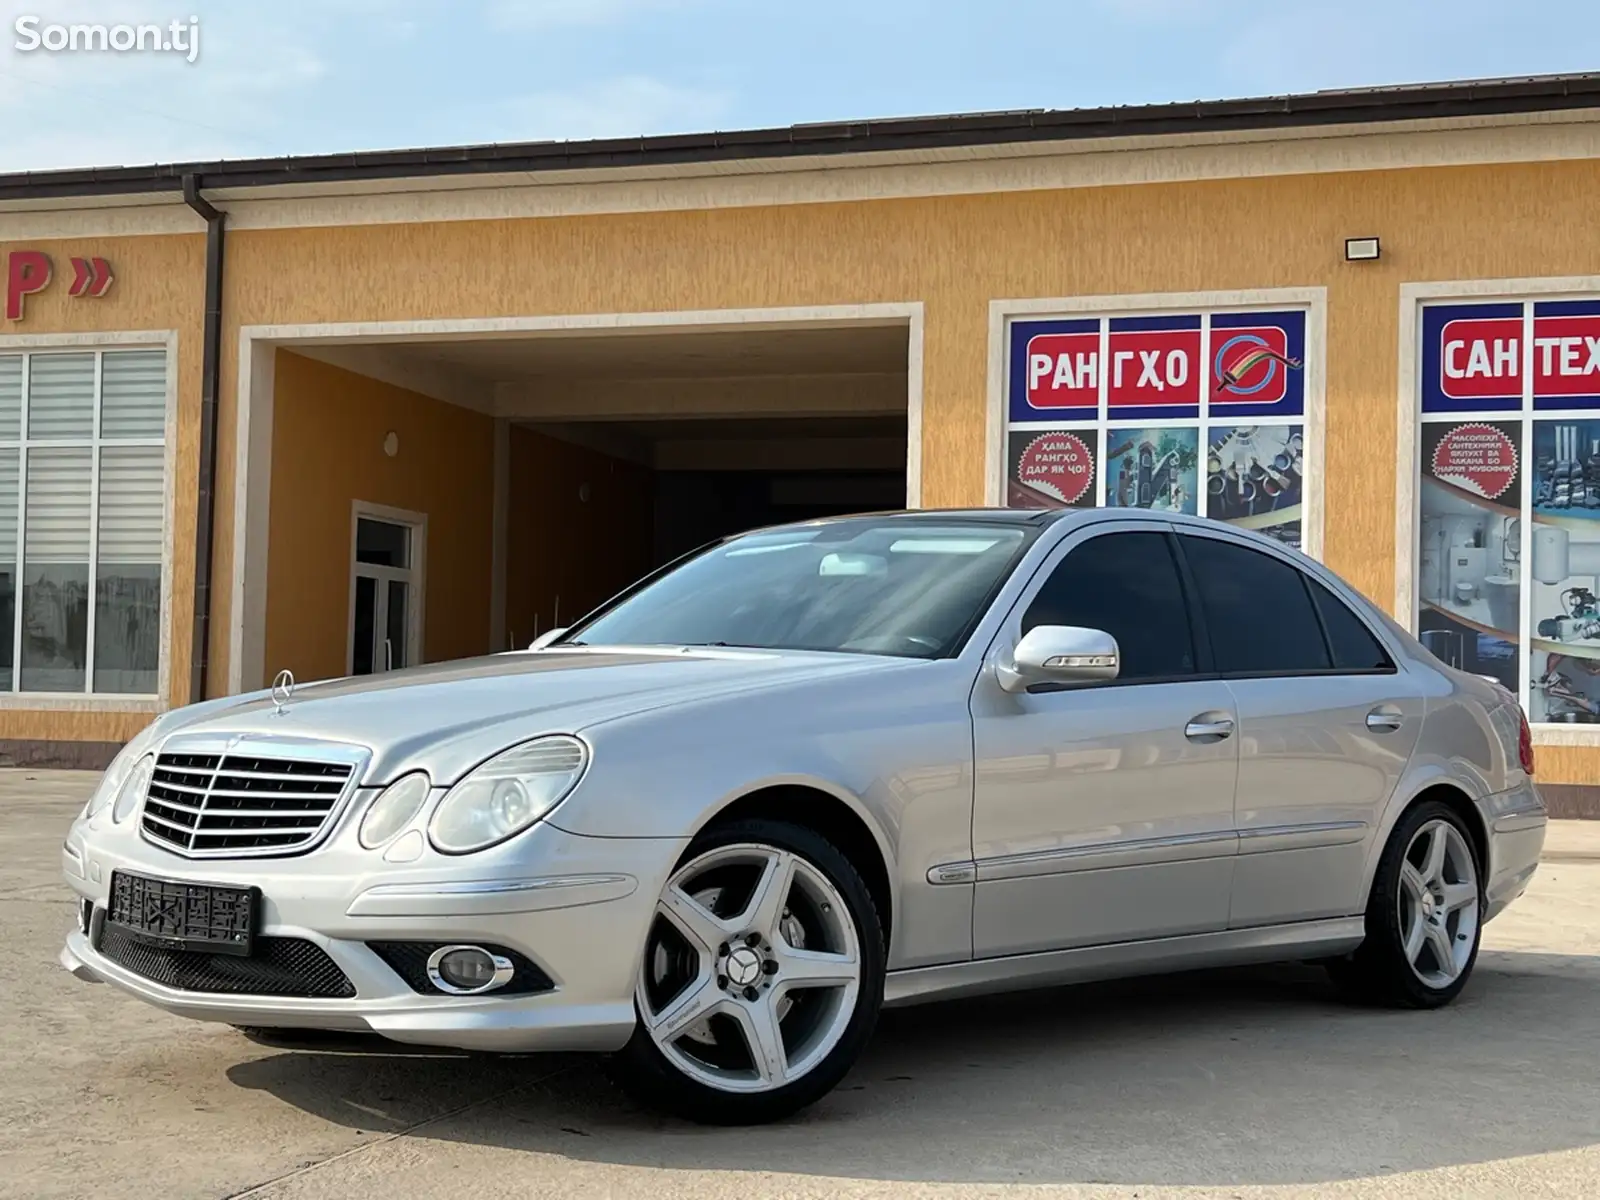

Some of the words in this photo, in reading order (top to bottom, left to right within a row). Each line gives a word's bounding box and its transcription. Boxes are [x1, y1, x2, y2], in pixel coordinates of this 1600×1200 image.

[1030, 350, 1188, 391] РАНГҲО
[1026, 465, 1048, 475] ДАР
[1051, 465, 1065, 474] ЯК
